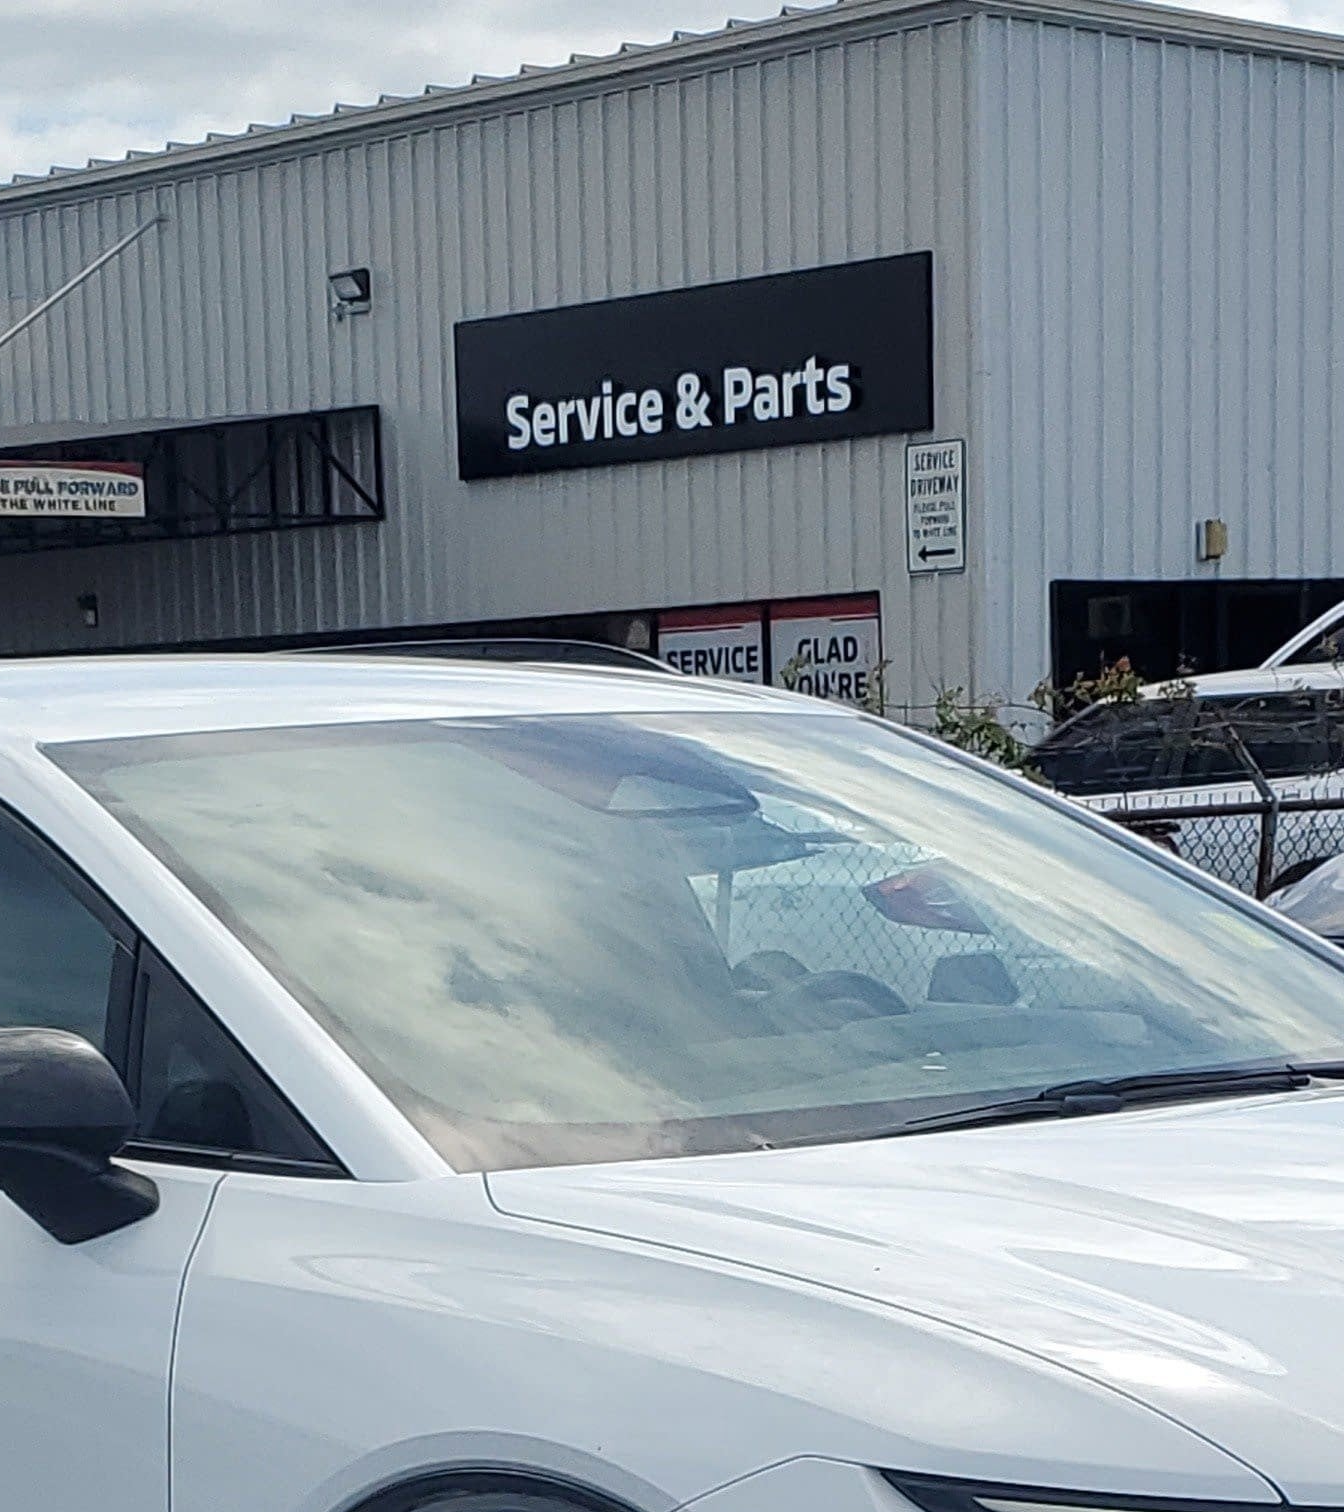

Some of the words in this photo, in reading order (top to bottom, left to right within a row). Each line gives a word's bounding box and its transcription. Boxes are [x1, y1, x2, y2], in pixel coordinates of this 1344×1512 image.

[506, 379, 663, 450] Service
[675, 372, 712, 430] &
[723, 355, 852, 425] Parts
[915, 449, 955, 471] SERVICE
[14, 477, 53, 495] PULL
[58, 480, 138, 496] FORWARD
[910, 474, 959, 497] DRIVEWAY
[0, 499, 28, 510] THE
[33, 499, 81, 511] WHITE
[85, 500, 116, 511] LINE
[666, 645, 759, 676] SERVICE
[798, 636, 858, 665] GLAD
[783, 671, 867, 699] YOU'RE
